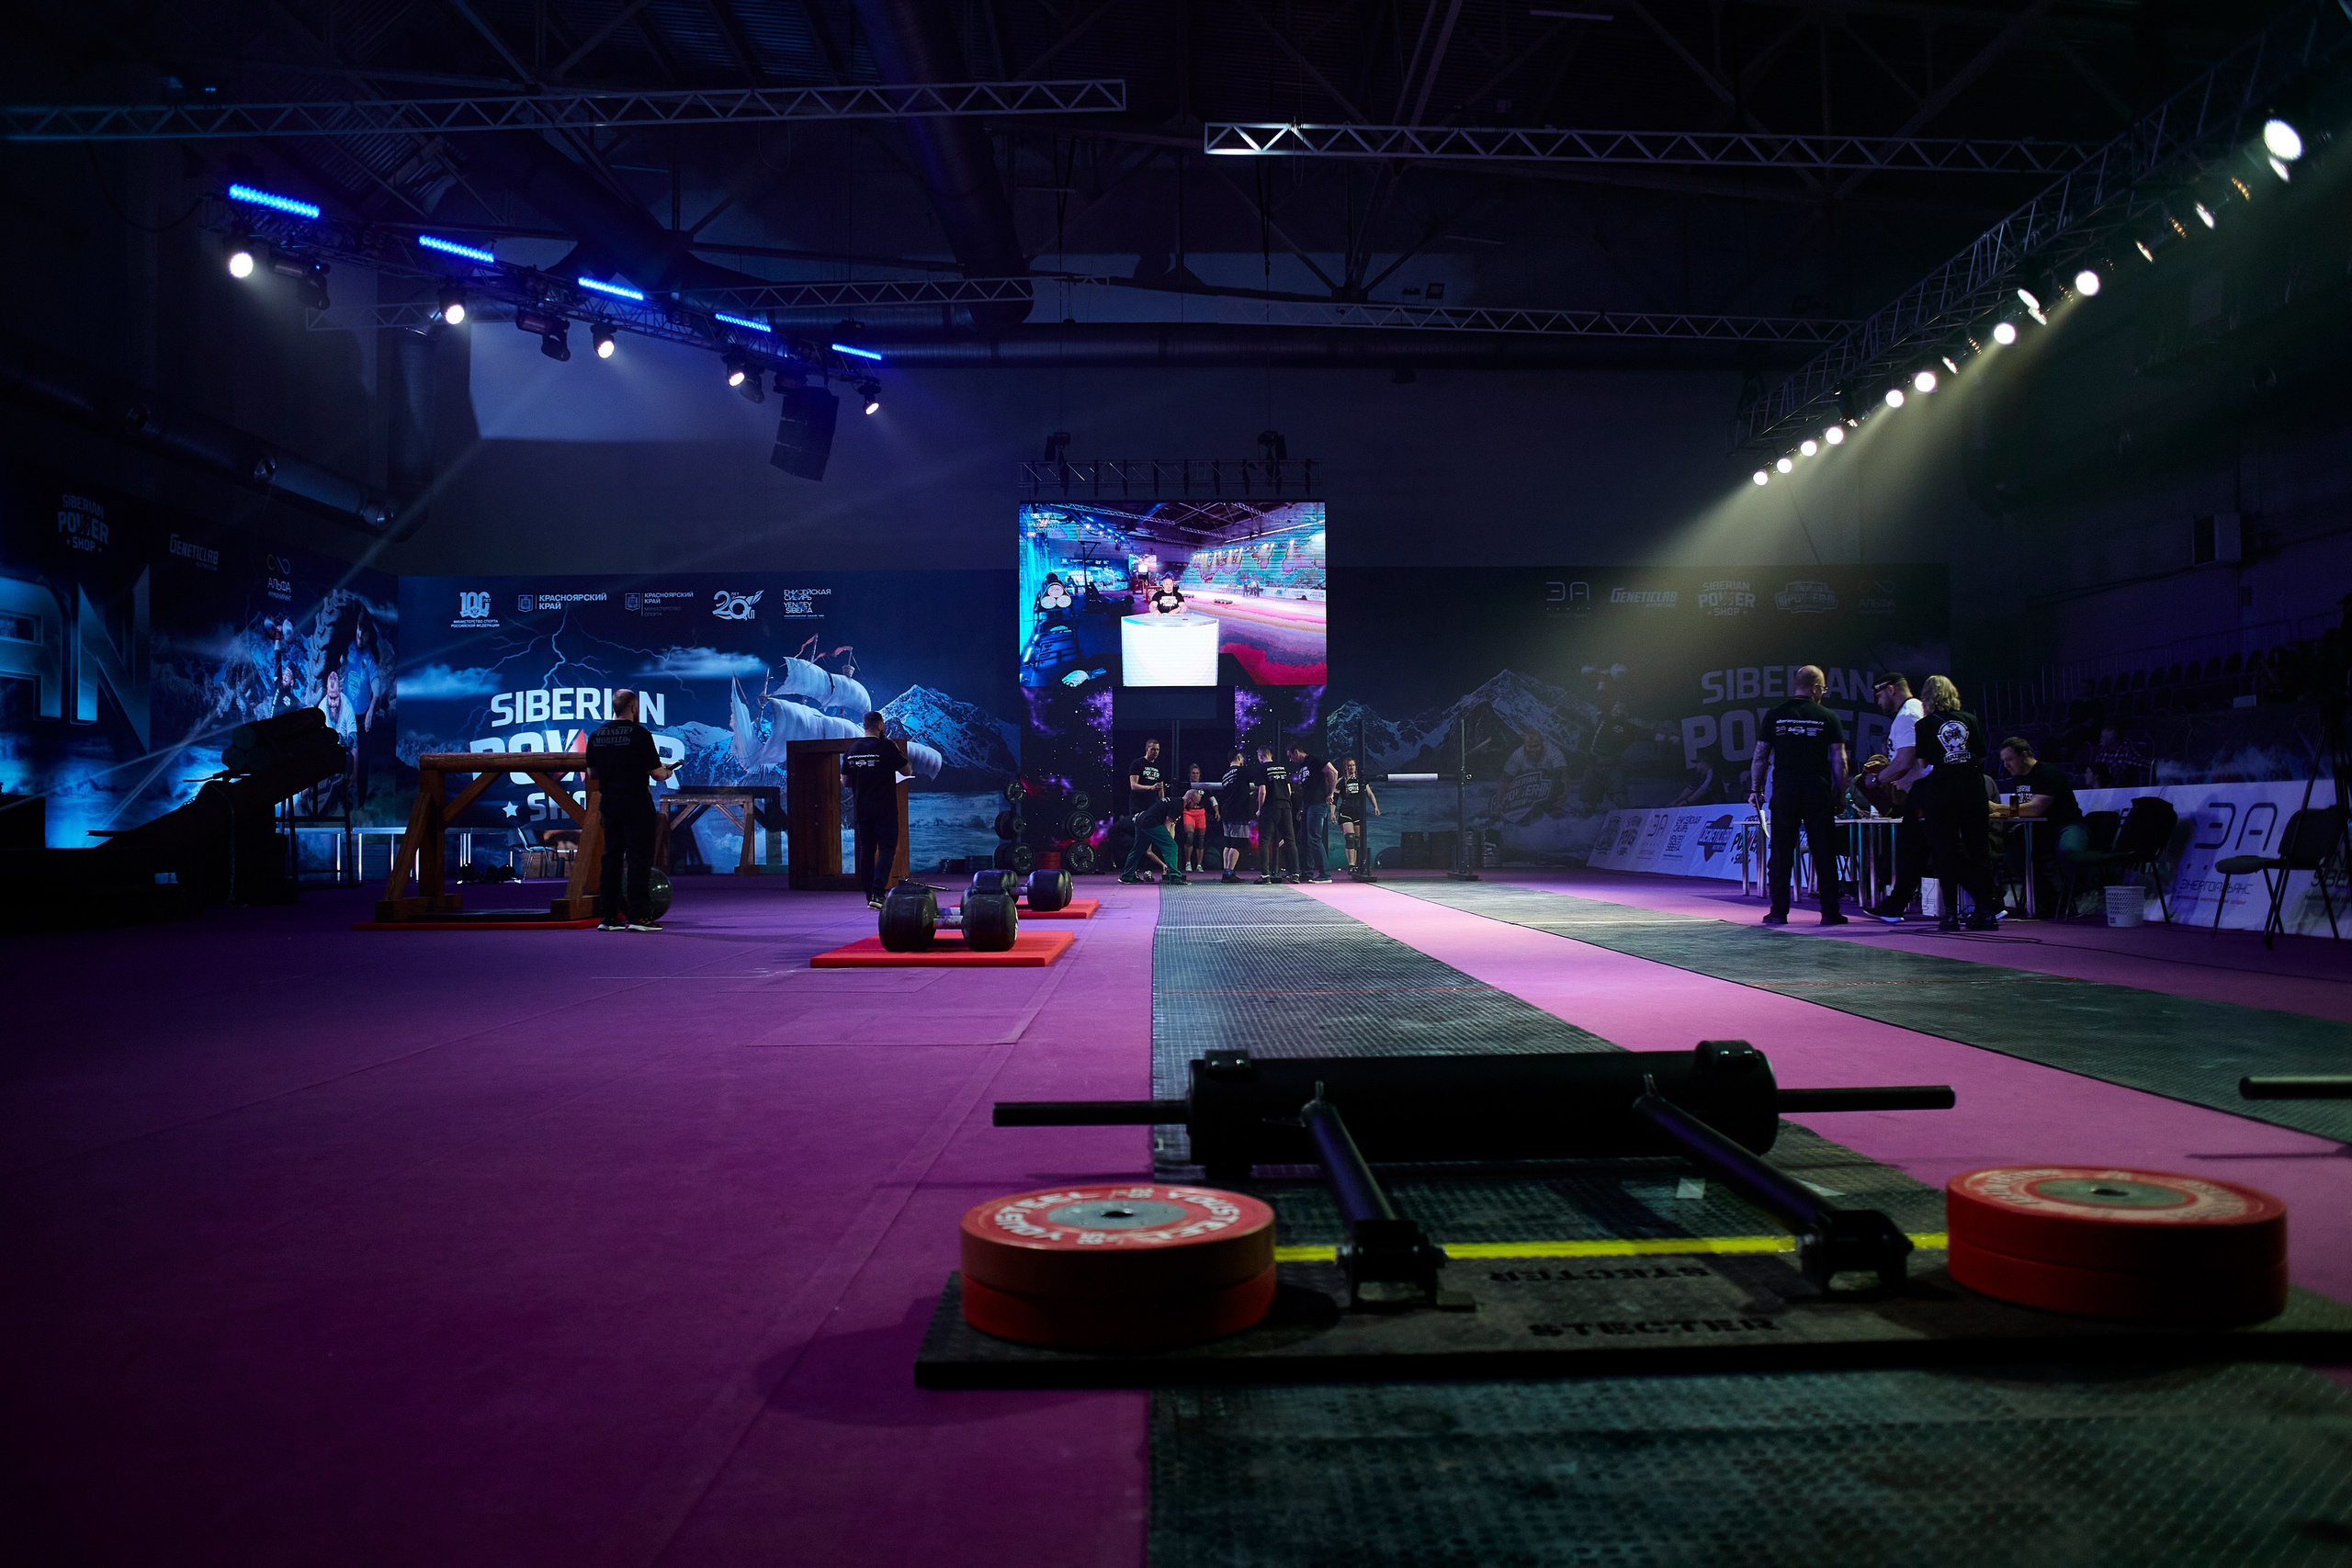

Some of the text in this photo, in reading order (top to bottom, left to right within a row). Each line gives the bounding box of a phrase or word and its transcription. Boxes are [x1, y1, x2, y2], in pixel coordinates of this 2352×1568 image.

[62, 494, 105, 519] SIBERIAN
[57, 511, 109, 546] POWER
[1702, 581, 1750, 592] SIBERIAN
[539, 592, 607, 602] КРАСНОЯРСКИЙ
[1698, 592, 1757, 609] POWER
[539, 602, 561, 610] КРАЙ
[1702, 665, 1875, 705] SIBEAN
[491, 687, 665, 728] SIBERIN
[2178, 878, 2254, 895] ЭНЕРГОАЬЯНС
